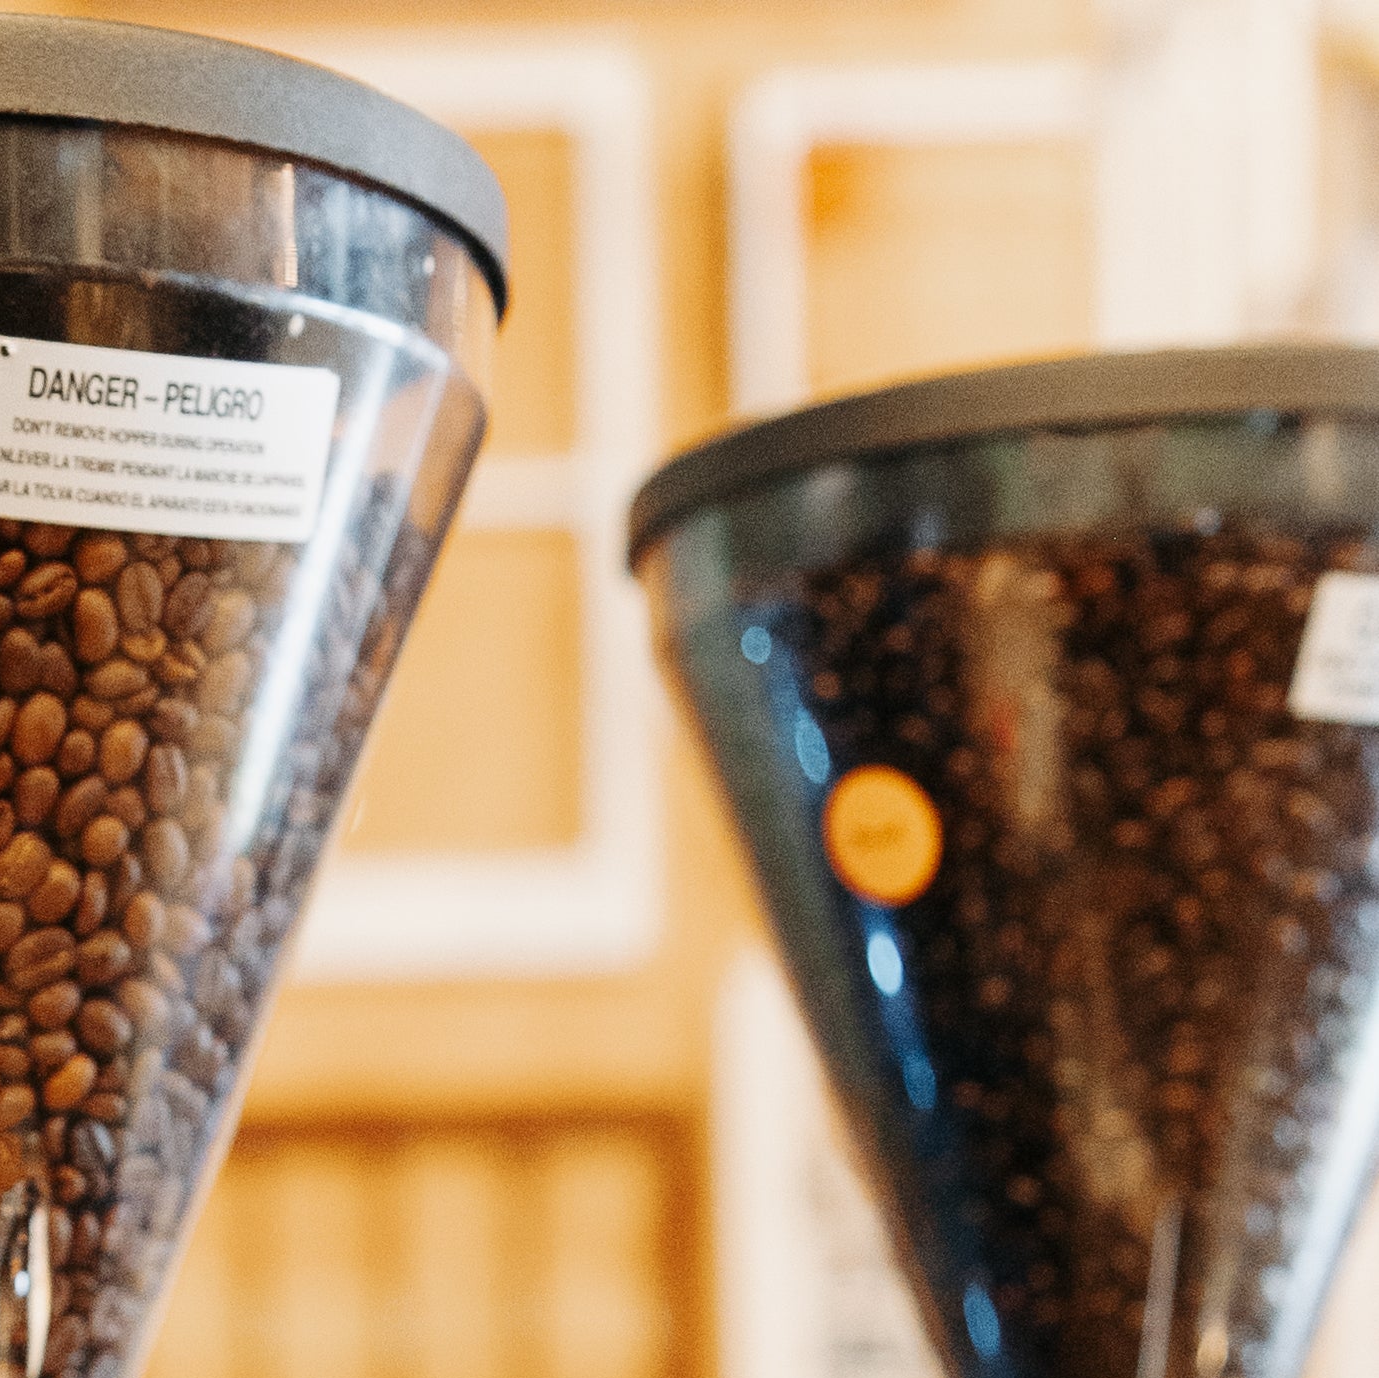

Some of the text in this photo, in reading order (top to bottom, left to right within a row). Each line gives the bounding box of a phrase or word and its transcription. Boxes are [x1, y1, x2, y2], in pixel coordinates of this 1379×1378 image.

[29, 366, 139, 409] DANGER
[164, 381, 264, 421] PELIGRO
[12, 417, 52, 435] DON'T
[55, 422, 106, 441] REMOVE
[109, 428, 156, 446] HOPPER
[54, 455, 70, 468] LA
[13, 481, 30, 495] LA
[33, 482, 72, 500] TOLVA
[75, 487, 128, 507] CUANDO
